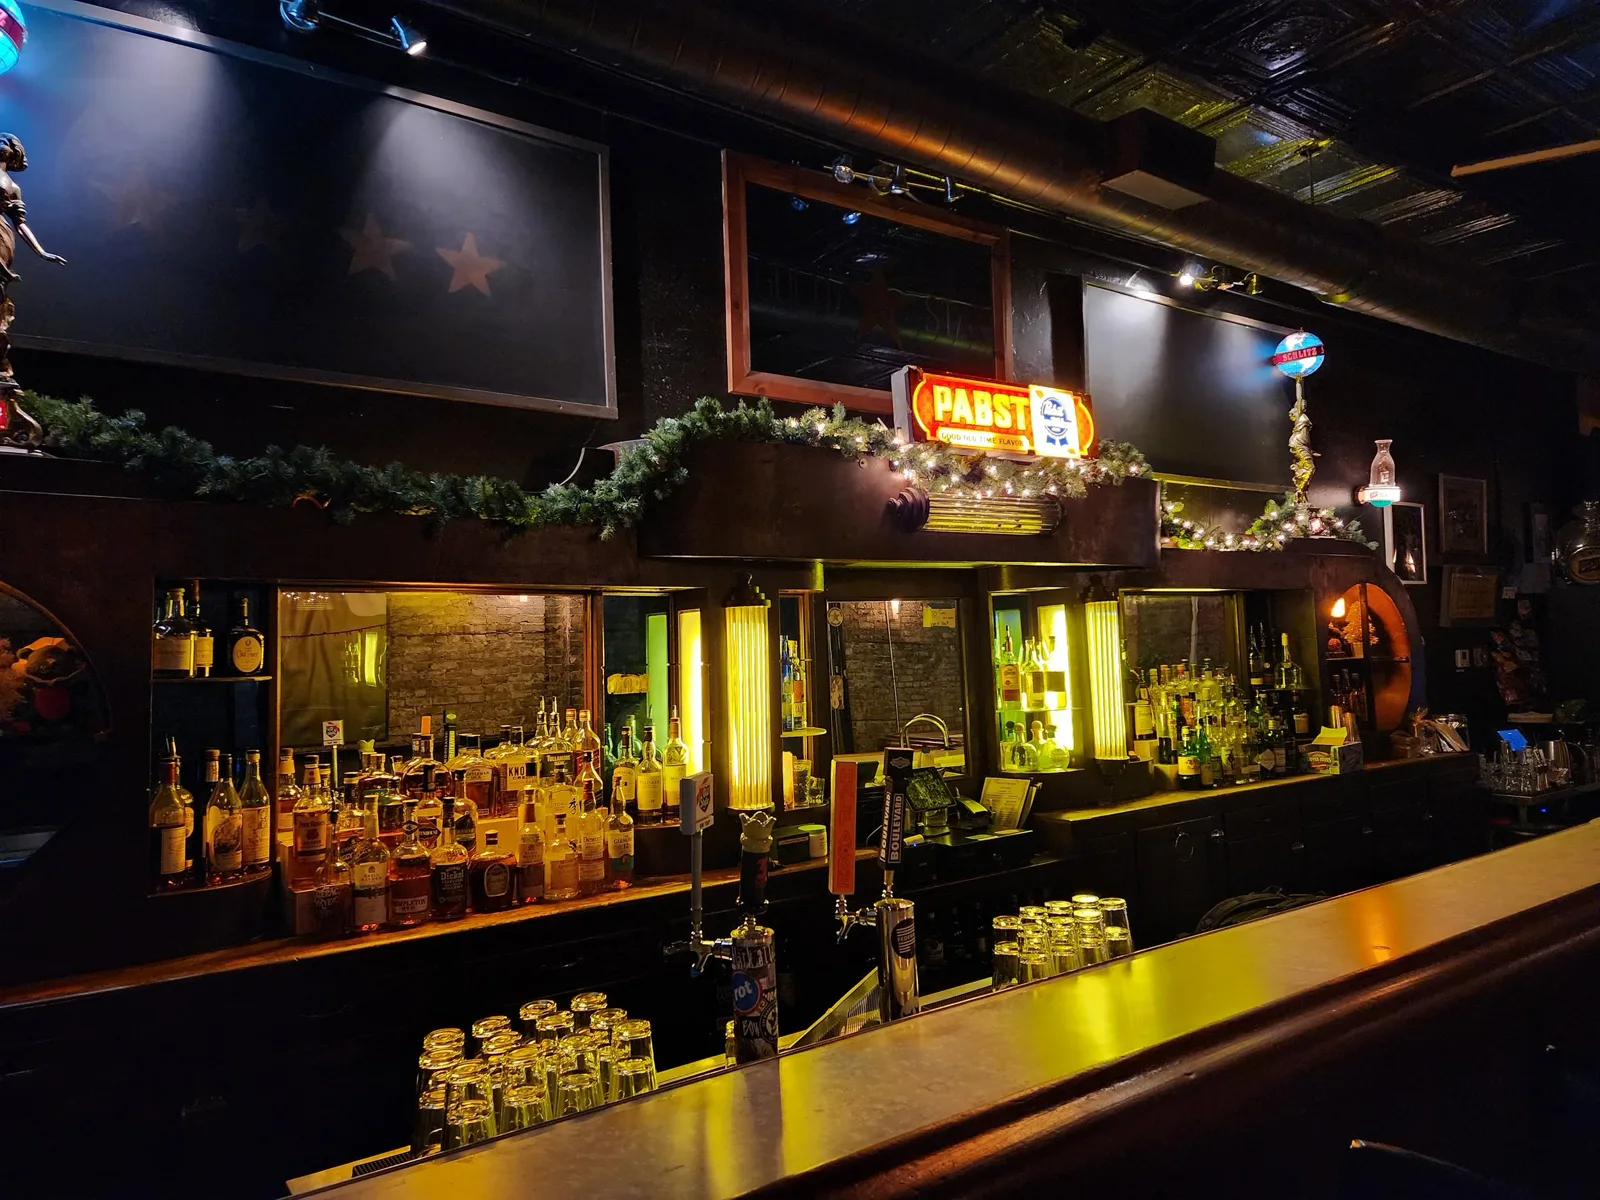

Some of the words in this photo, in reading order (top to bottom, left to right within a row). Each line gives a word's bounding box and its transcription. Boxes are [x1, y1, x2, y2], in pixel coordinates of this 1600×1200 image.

[1282, 347, 1317, 362] SCHLITZ
[932, 384, 1030, 431] PABST
[941, 432, 962, 442] GOOD
[963, 434, 977, 444] OLD
[979, 437, 997, 445] TIME
[999, 438, 1024, 447] FLAVOR
[508, 766, 526, 777] KNO
[881, 793, 891, 859] BOULEVARD
[890, 795, 903, 861] BOULEVARD
[440, 869, 465, 881] Dickel
